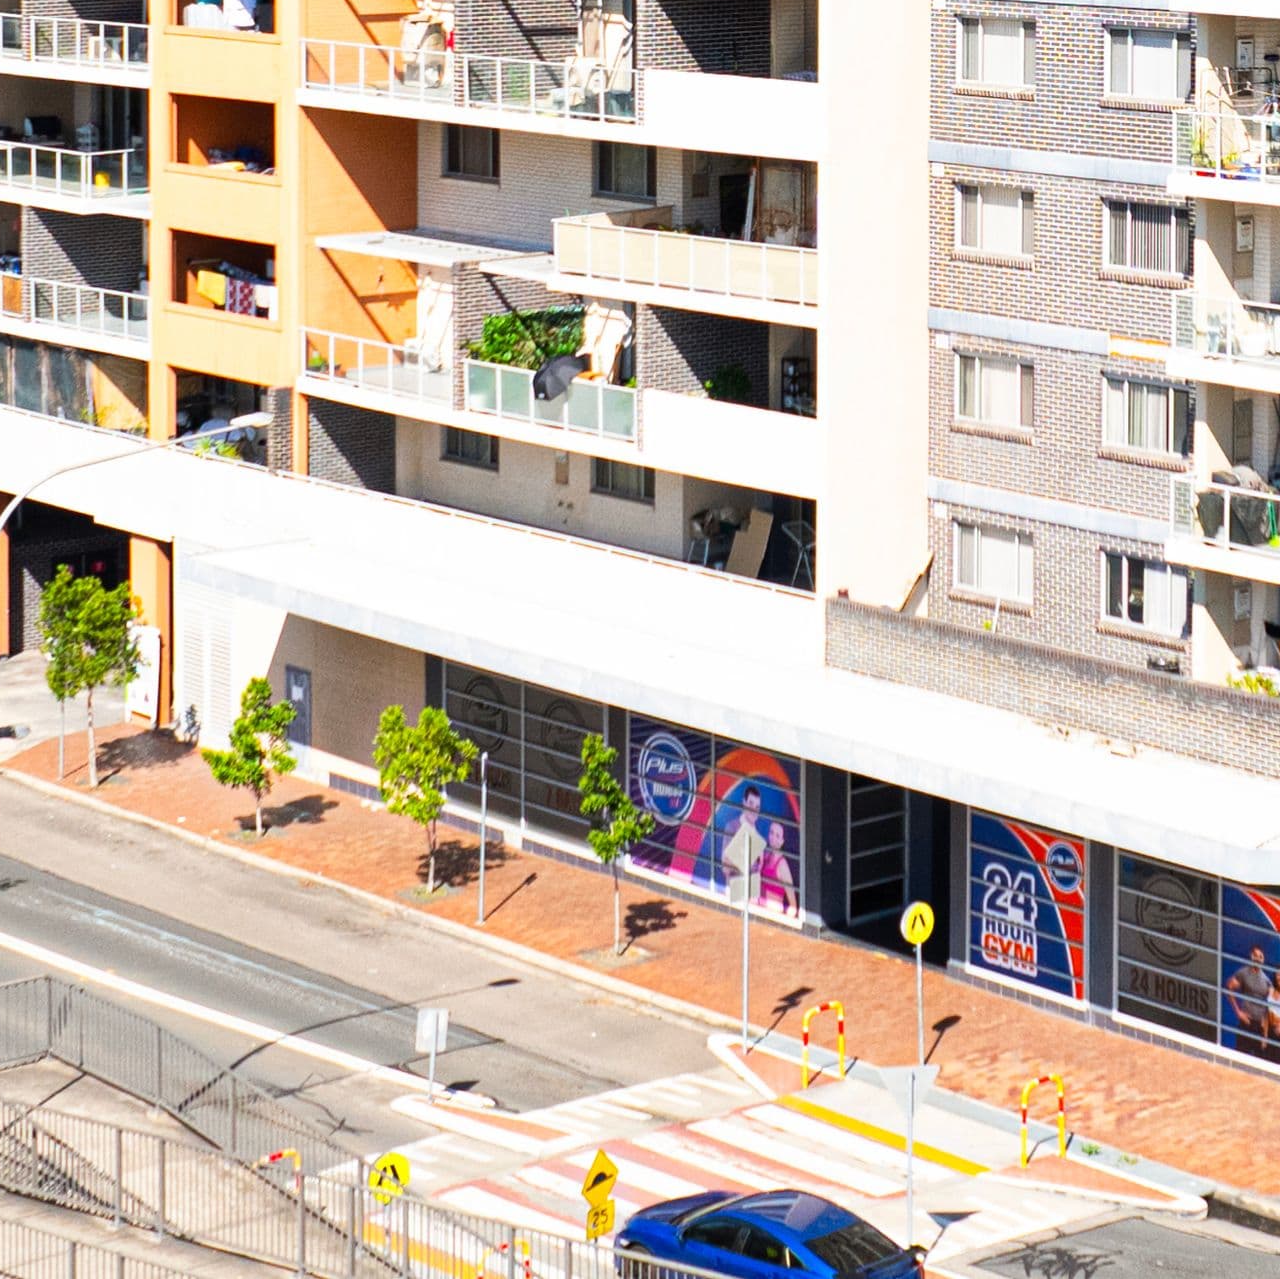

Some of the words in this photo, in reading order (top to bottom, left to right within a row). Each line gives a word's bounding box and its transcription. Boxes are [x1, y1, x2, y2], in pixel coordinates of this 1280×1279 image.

[983, 865, 1036, 925] 24
[984, 917, 1035, 945] HOUR
[982, 932, 1037, 974] GYM
[1129, 968, 1151, 994] 24
[1153, 975, 1210, 1015] HOURS
[592, 1209, 608, 1228] 25
